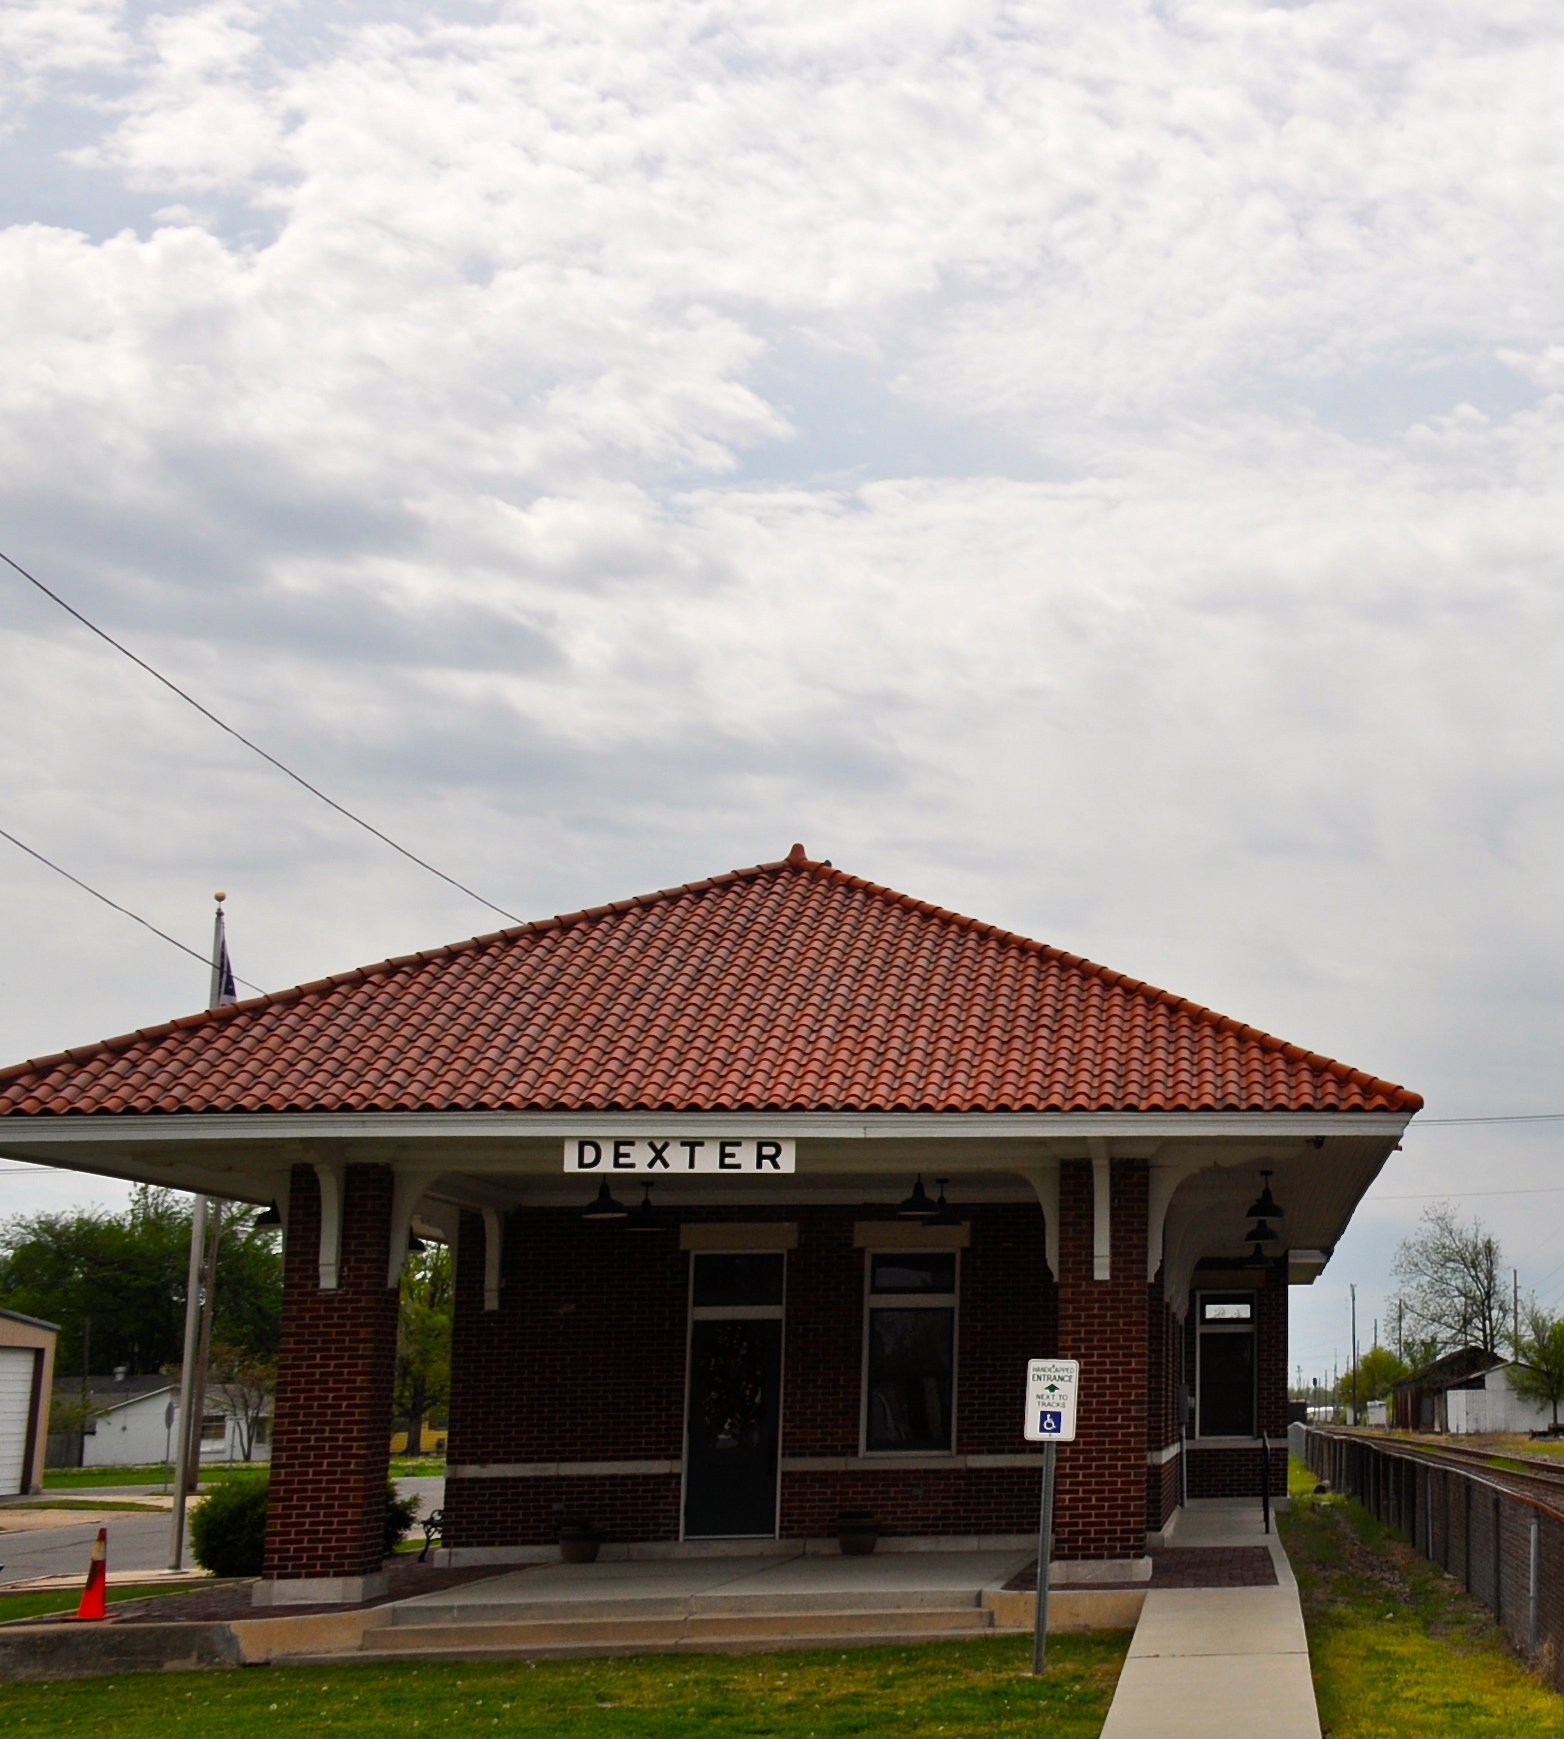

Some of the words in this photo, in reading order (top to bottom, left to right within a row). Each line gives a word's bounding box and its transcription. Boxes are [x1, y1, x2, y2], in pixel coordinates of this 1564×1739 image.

[577, 1140, 782, 1169] DEXTER
[1032, 1366, 1074, 1374] HANDICAPPED
[1032, 1374, 1073, 1383] ENTRANCE
